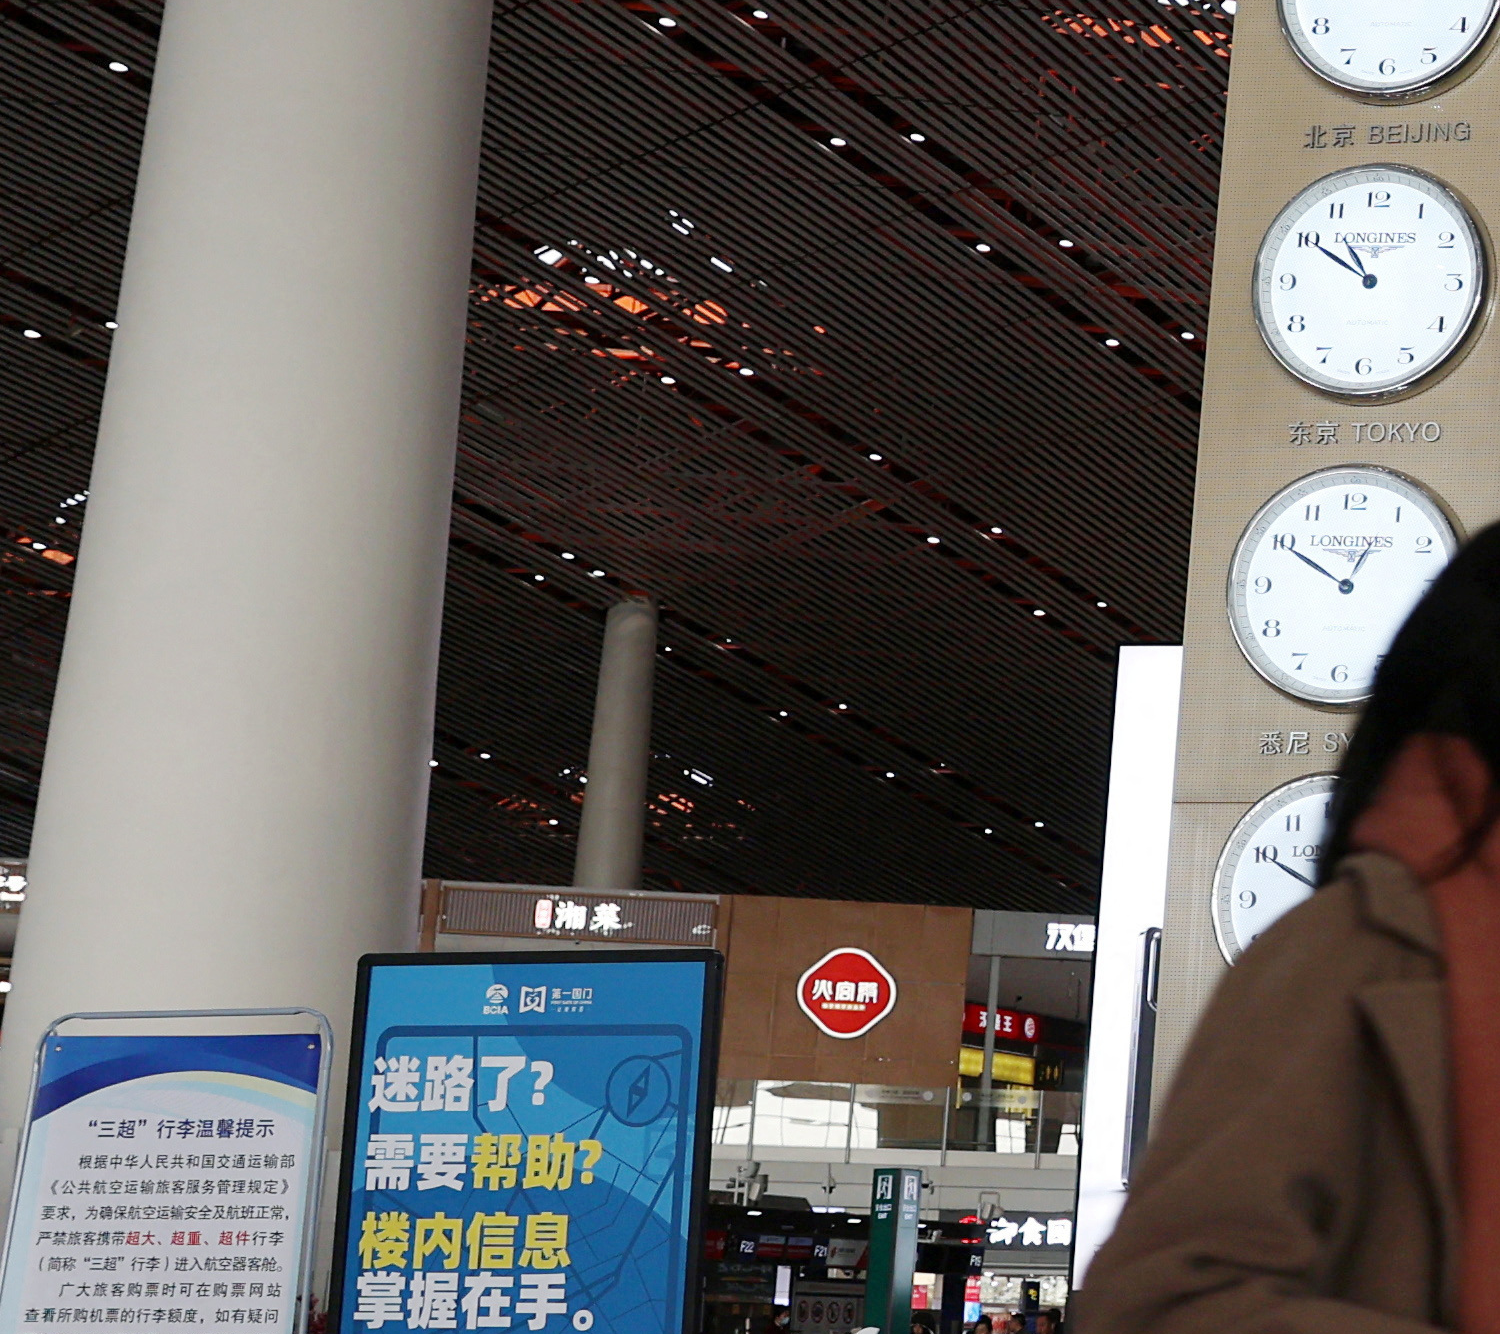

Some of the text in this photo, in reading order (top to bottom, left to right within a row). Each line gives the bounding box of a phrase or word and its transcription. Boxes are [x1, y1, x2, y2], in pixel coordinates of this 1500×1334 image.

[1303, 122, 1471, 148] 北京 BEIJING
[1289, 421, 1440, 444] 东京 TOKYO
[1259, 731, 1309, 755] 悉尼
[555, 901, 622, 931] 湘菜
[551, 988, 592, 1000] 第一国门
[483, 1006, 508, 1015] BCIA
[157, 1119, 274, 1138] 行李温馨提示
[79, 1154, 295, 1169] 根据中华人民共和国交通运输部
[359, 1212, 570, 1269] 楼内信息
[740, 1241, 753, 1253] F22
[58, 1282, 281, 1297] 广大旅客购票时可在购票网站
[354, 1272, 594, 1331] 掌握在手。
